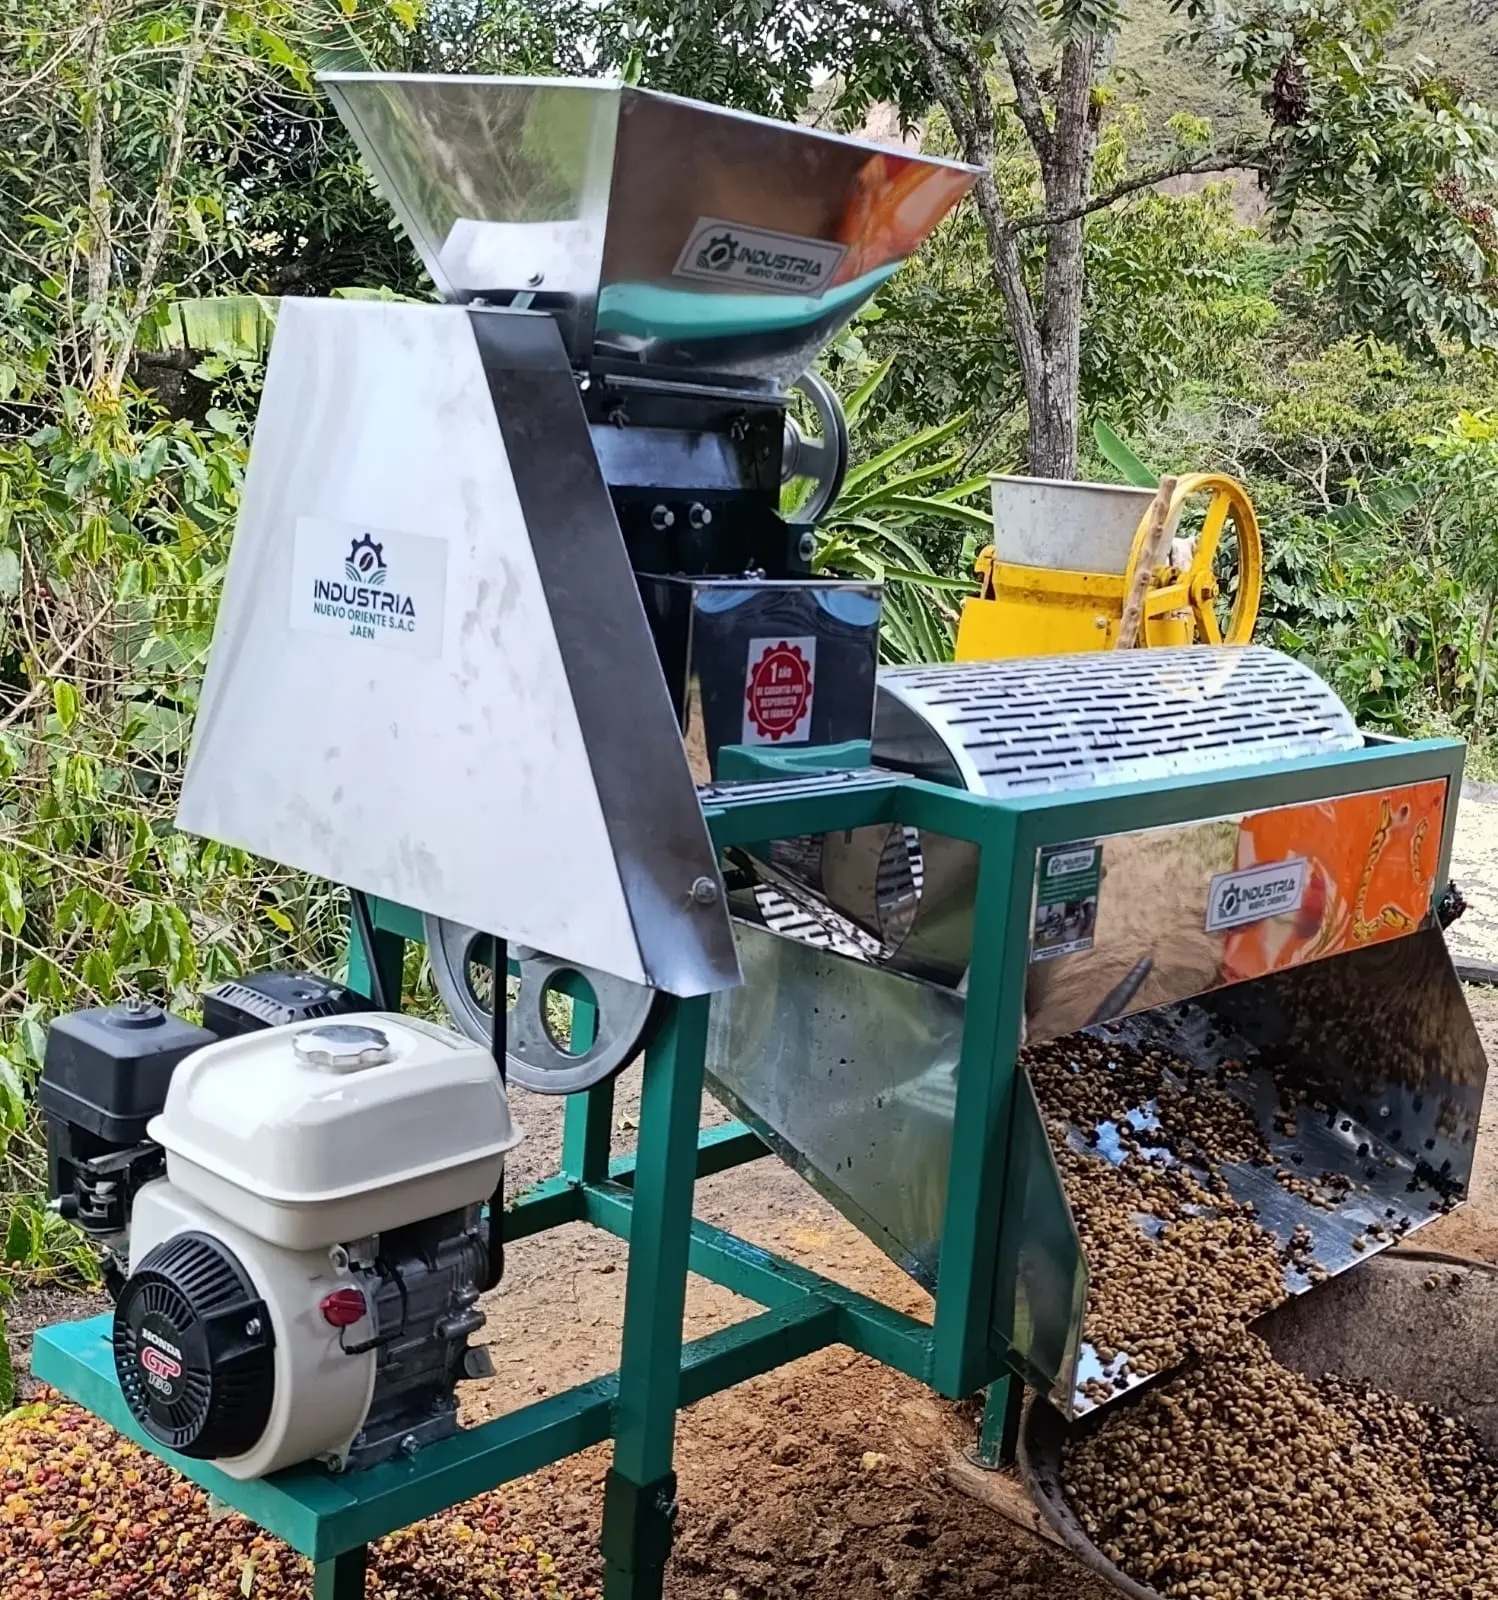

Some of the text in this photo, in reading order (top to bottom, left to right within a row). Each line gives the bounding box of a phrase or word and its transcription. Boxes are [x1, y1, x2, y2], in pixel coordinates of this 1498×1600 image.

[737, 247, 822, 277] INDUSTRIA
[313, 578, 416, 617] INDUSTRIA
[313, 601, 415, 633] NUEVO ORIENTE S.A.C
[349, 624, 375, 640] JAEN
[770, 661, 778, 684] 1
[1242, 878, 1295, 901] INDUSTRIA
[142, 1327, 182, 1360] HONDA
[141, 1346, 181, 1380] GP
